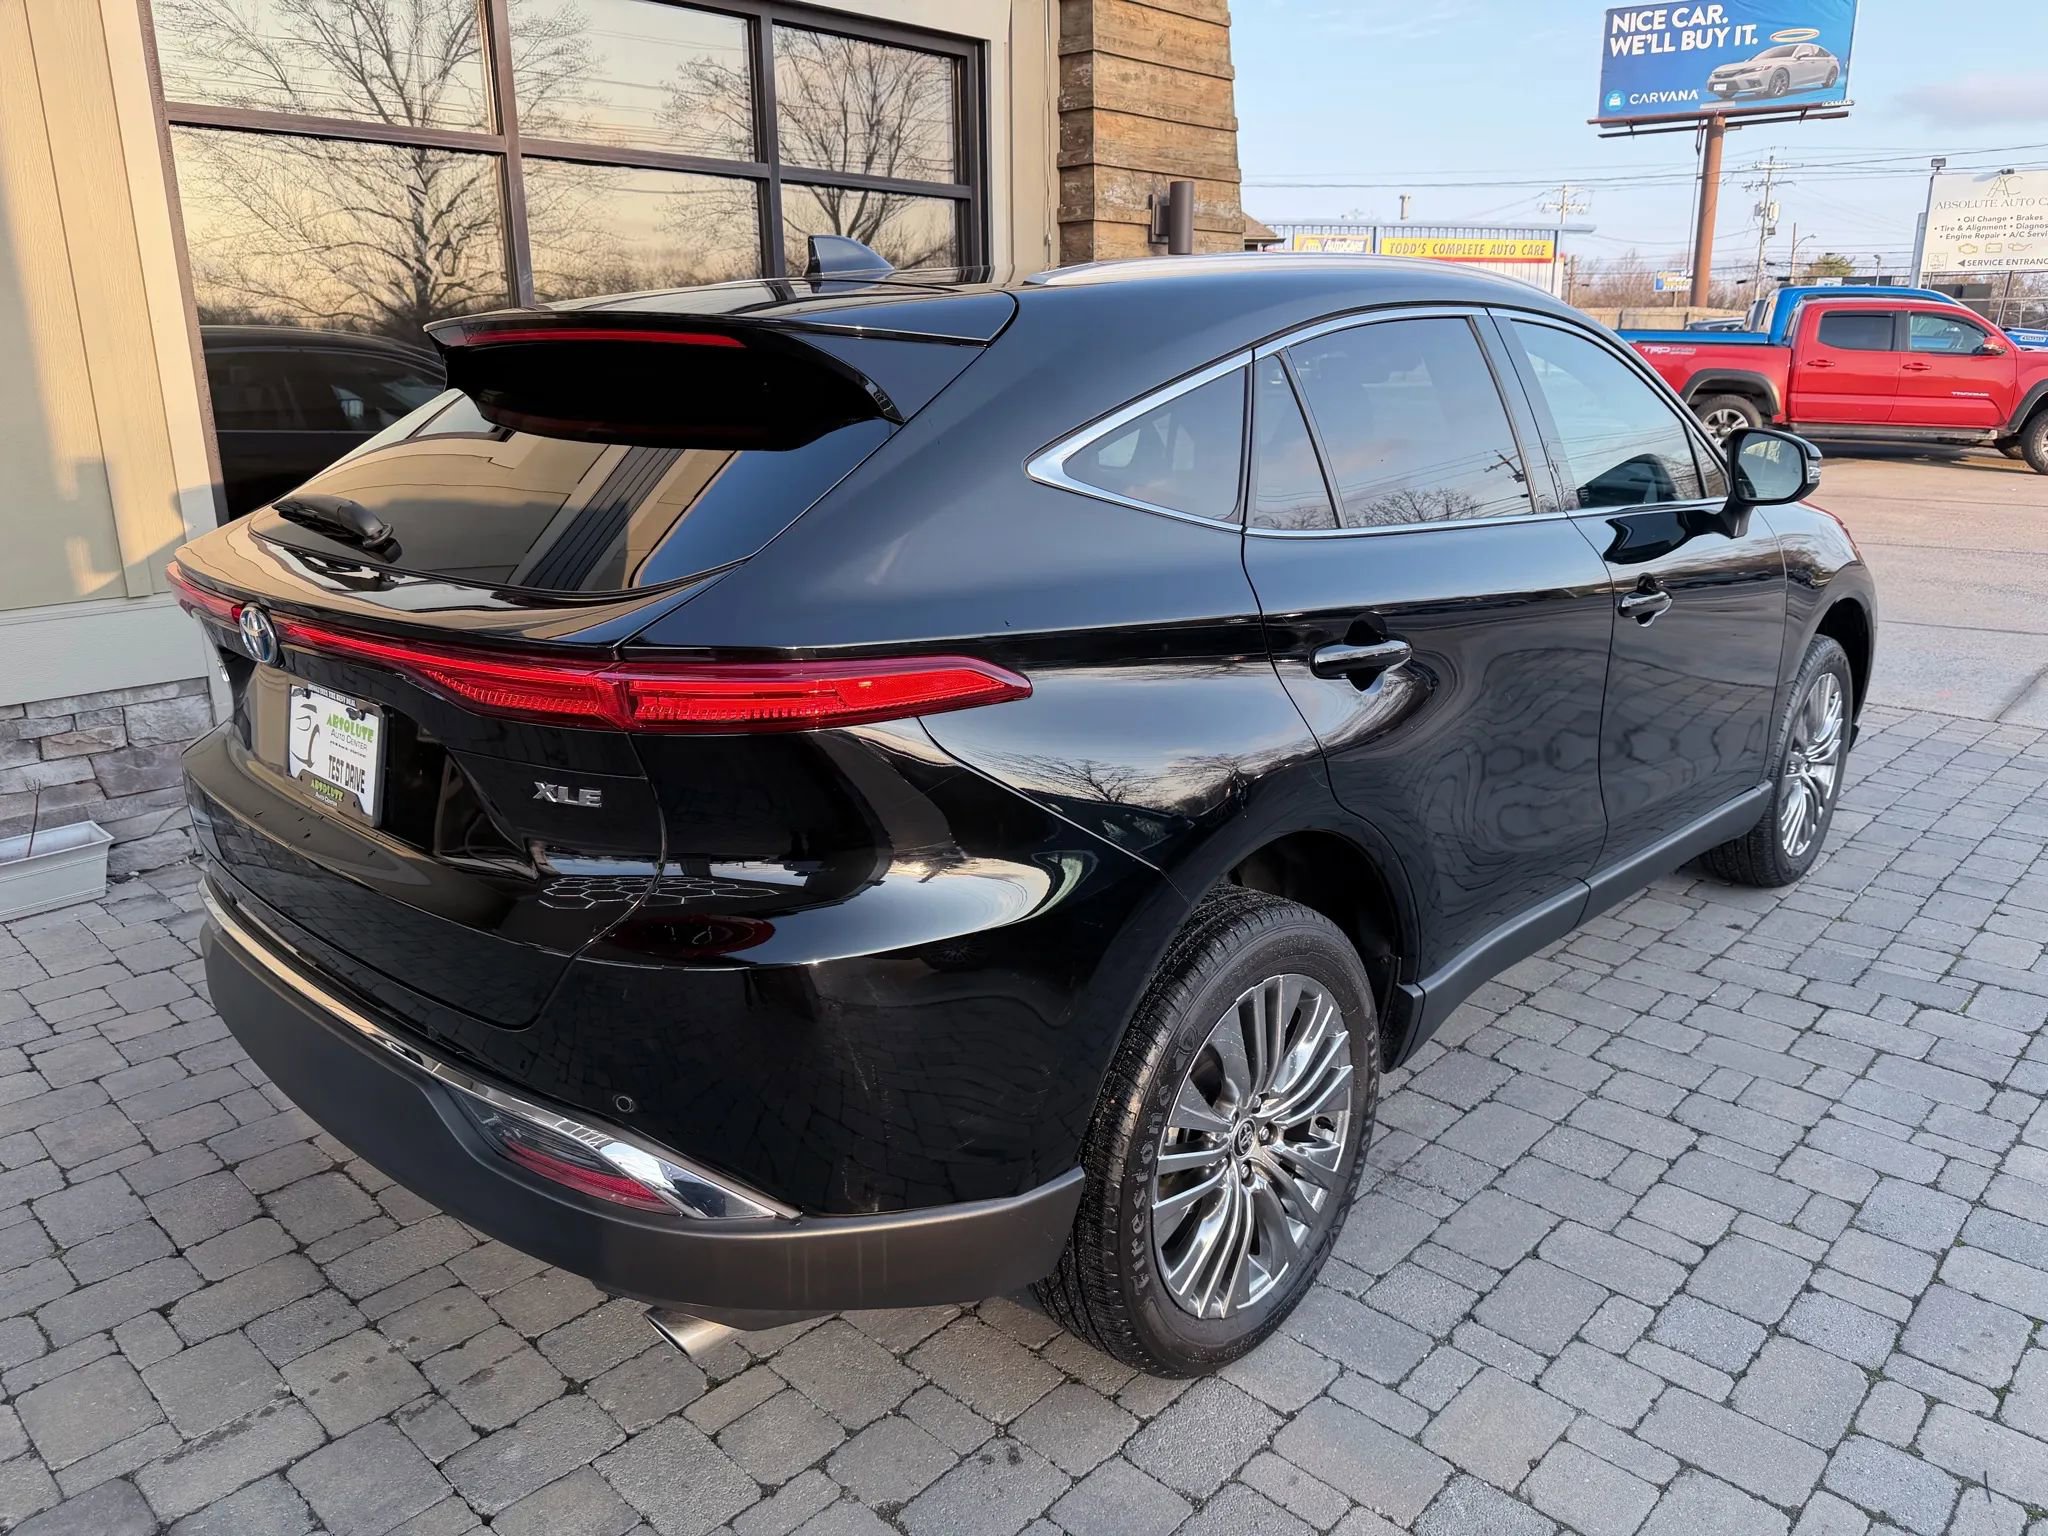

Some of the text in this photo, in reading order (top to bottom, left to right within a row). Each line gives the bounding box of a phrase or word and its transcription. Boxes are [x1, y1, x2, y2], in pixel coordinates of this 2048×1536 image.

[1611, 5, 1729, 35] NICE CAR.
[1609, 24, 1759, 58] WE'LL BUY IT.
[1629, 89, 1700, 104] CARVANA
[1935, 200, 1998, 210] ABSOLUTE
[2001, 198, 2035, 207] AUTO
[1963, 215, 1975, 223] Oil
[1977, 214, 2007, 223] Change
[1966, 224, 2007, 232] Alignment
[1945, 232, 1972, 241] Engine
[1974, 232, 2000, 241] Repair
[2008, 231, 2025, 239] A/C
[1390, 242, 1546, 256] TODD'S COMPLETE AUTO CARE
[1966, 259, 2003, 267] SERVICE
[327, 714, 374, 742] ABSOLUTE
[328, 755, 366, 794] TEST DRIVE
[532, 781, 602, 808] XLE
